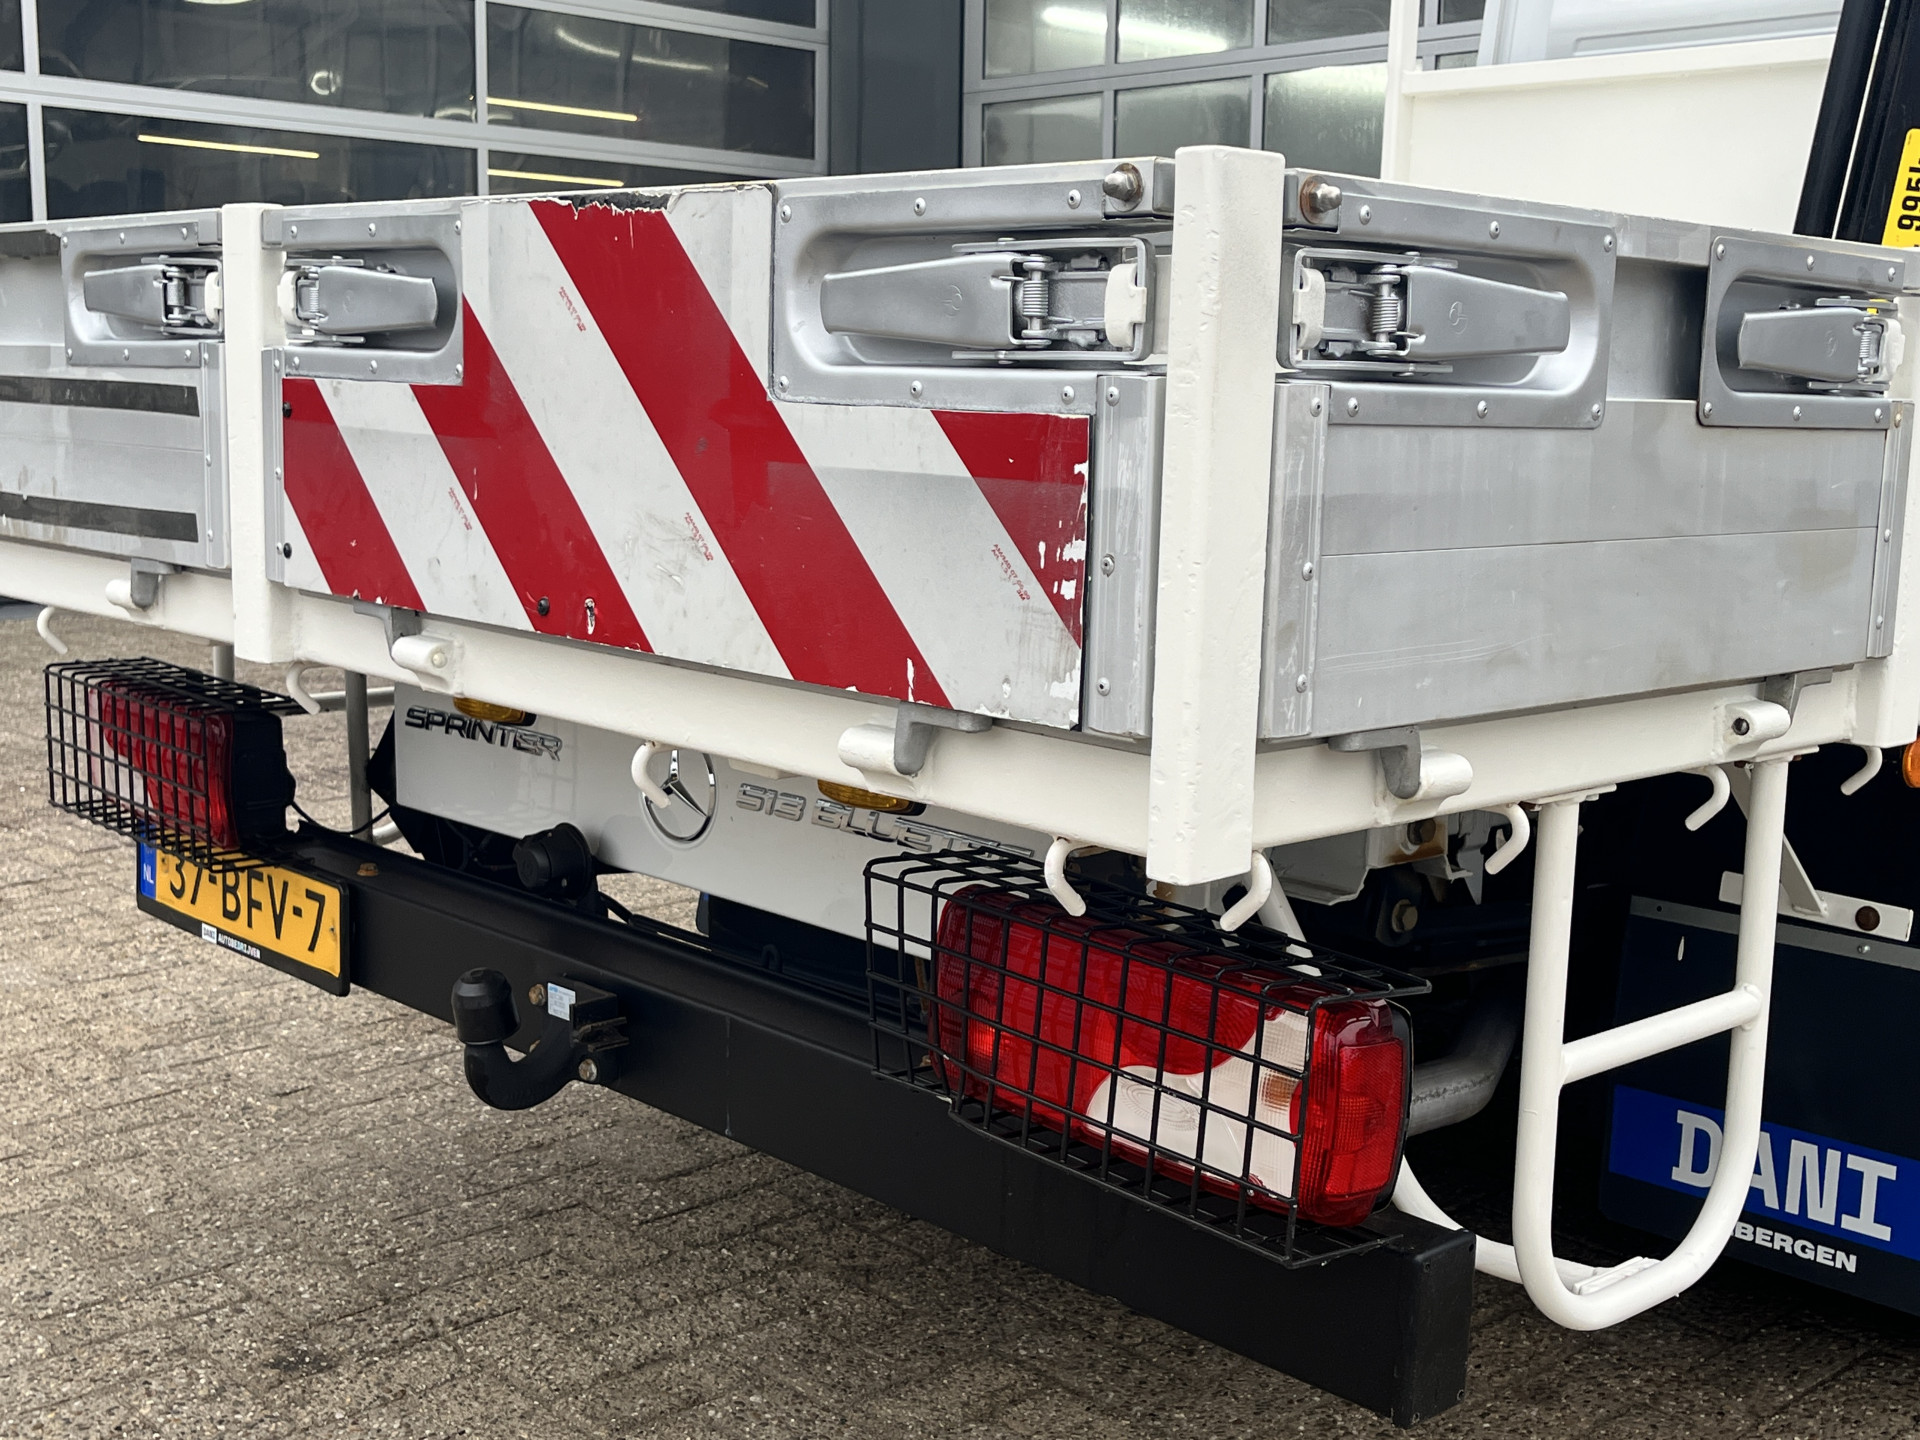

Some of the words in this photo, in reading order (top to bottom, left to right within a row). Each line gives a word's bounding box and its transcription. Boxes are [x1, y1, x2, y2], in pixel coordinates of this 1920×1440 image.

[405, 705, 563, 761] SPRINTER
[736, 782, 806, 822] 513
[811, 797, 1035, 858] BLUET
[143, 863, 154, 884] NL
[170, 843, 326, 953] 37-BFV-7
[1671, 1109, 1897, 1242] DANI
[1731, 1221, 1857, 1273] BERGEN
